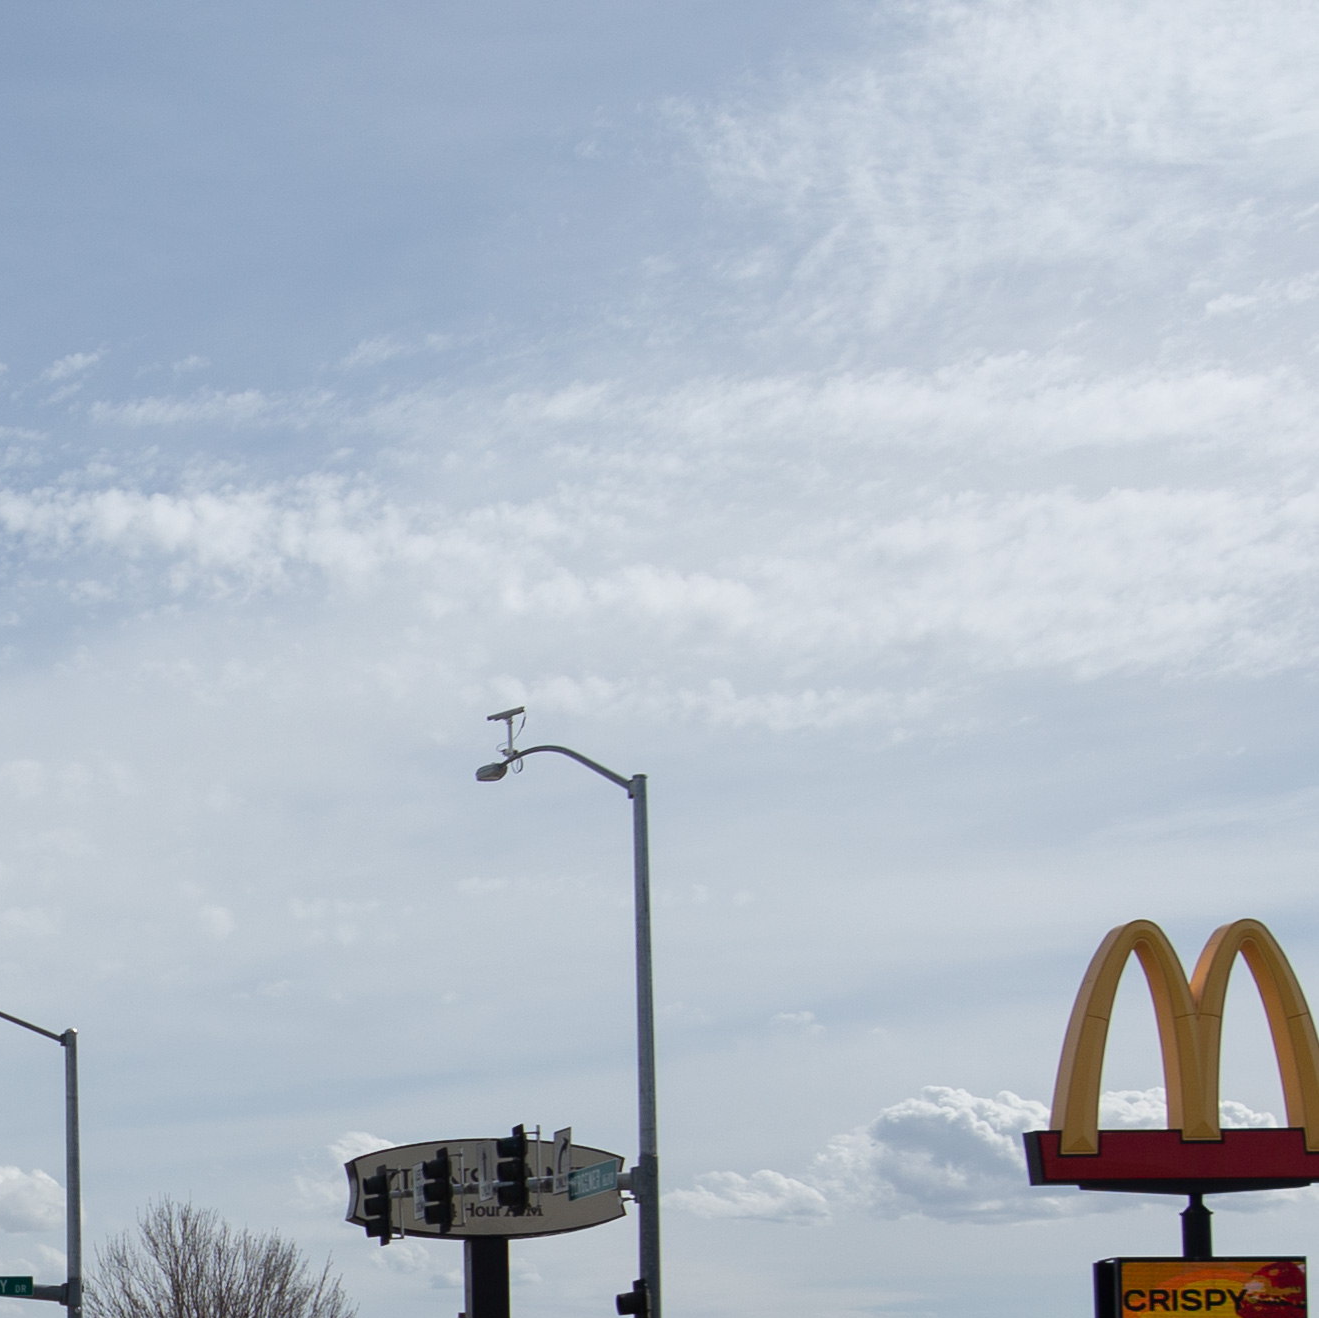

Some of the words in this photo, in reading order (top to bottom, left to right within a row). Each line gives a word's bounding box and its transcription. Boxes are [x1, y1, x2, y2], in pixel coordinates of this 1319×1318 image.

[464, 1203, 503, 1217] Hour
[504, 1203, 543, 1217] AM
[14, 1284, 27, 1293] DR
[1123, 1289, 1248, 1312] CRISPY
